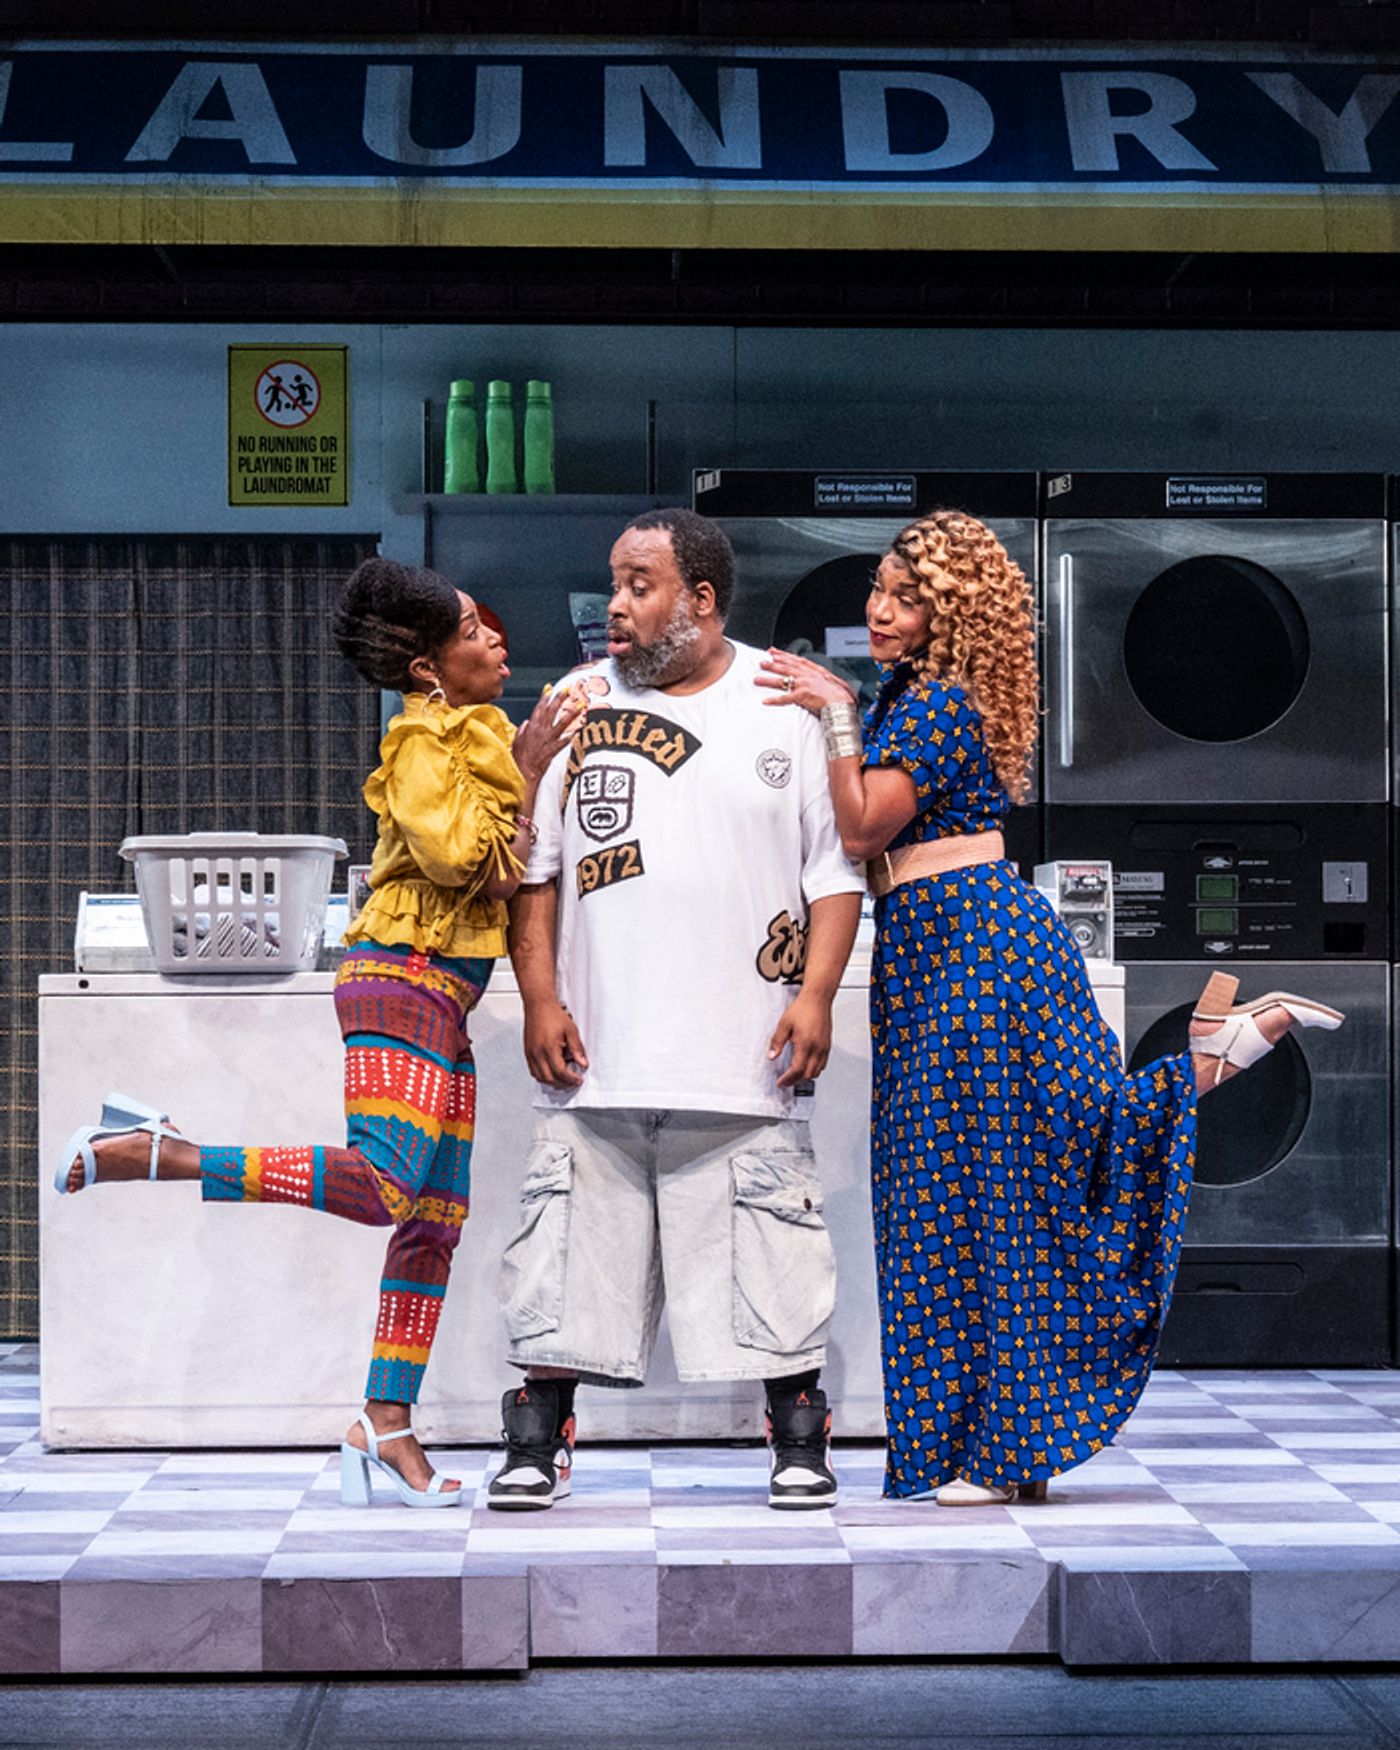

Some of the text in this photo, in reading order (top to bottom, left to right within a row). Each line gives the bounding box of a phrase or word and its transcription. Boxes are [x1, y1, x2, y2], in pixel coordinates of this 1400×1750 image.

[238, 436, 338, 453] NO RUNNING OR
[238, 456, 337, 473] PLAYING IN THE
[243, 476, 332, 494] LAUNDROMAT
[817, 482, 912, 493] Not Responsible For
[1052, 474, 1070, 494] 13
[1169, 484, 1264, 496] Not Responsible For
[819, 494, 840, 504] Lost
[1169, 495, 1191, 505] Lost
[1205, 494, 1235, 505] Stolen
[1236, 495, 1263, 505] Items
